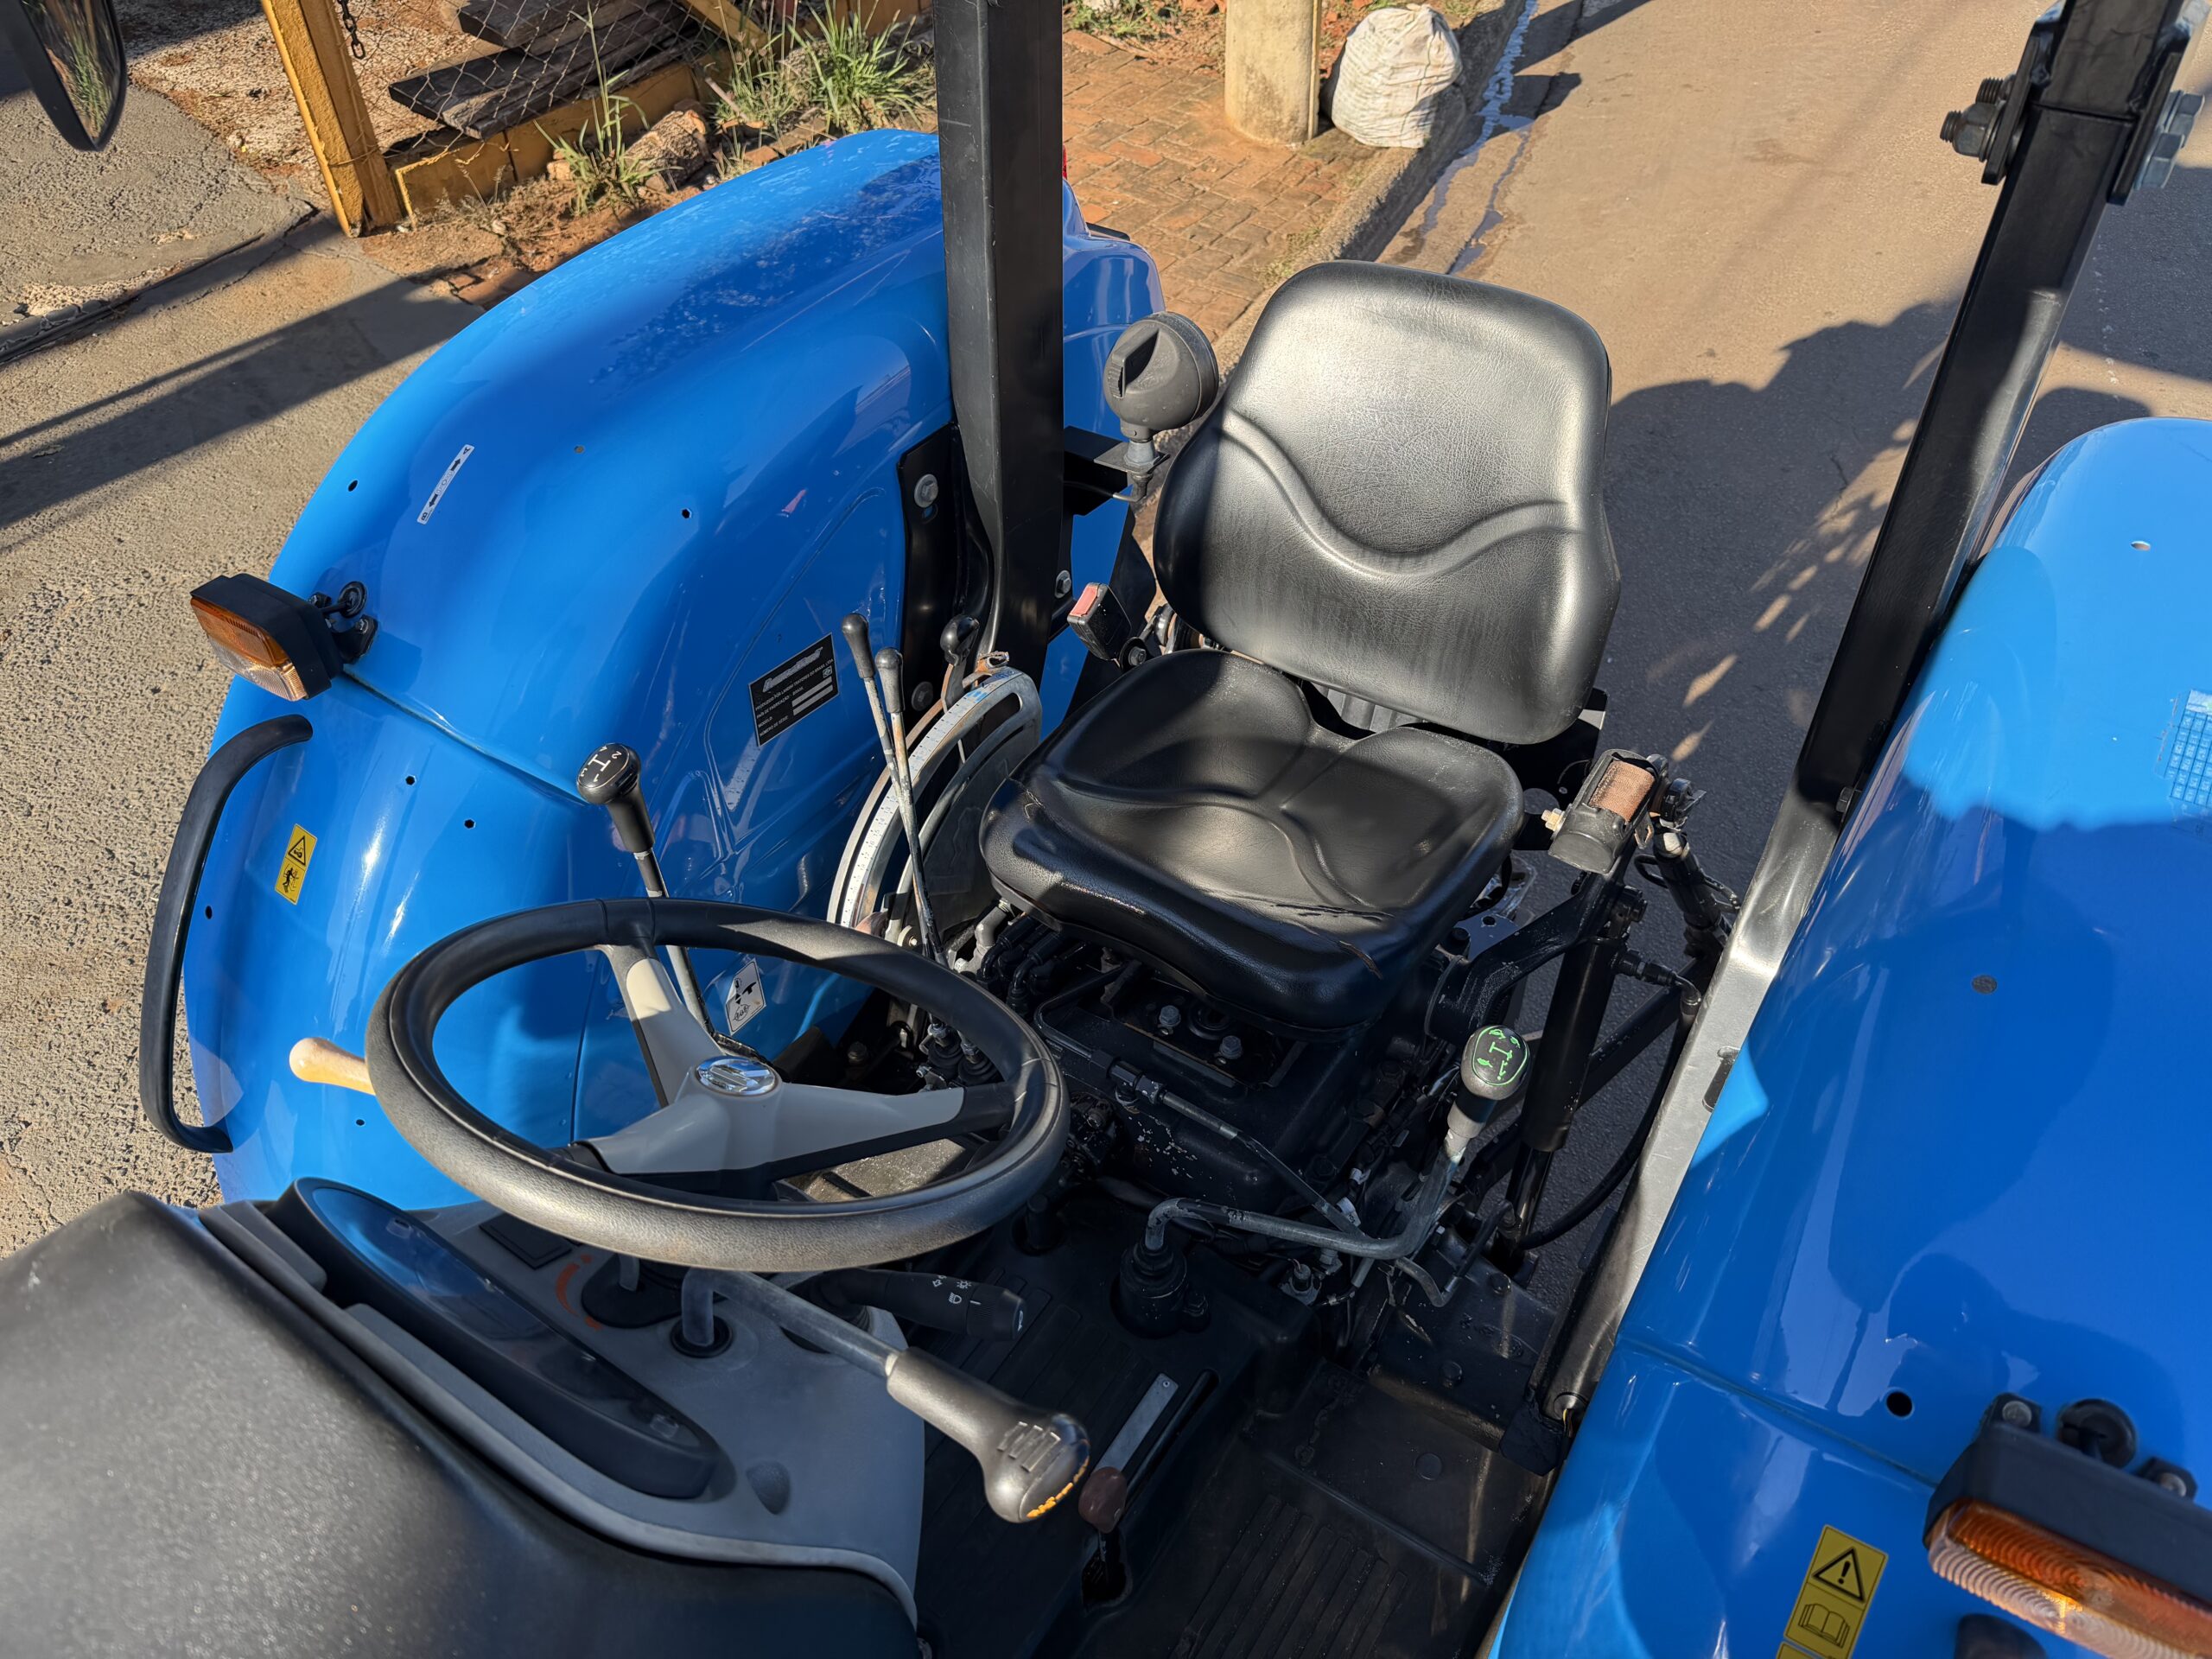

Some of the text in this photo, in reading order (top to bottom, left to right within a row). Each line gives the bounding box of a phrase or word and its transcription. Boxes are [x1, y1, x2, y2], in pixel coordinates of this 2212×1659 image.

[422, 512, 428, 521] B
[612, 751, 622, 760] 2
[580, 767, 600, 783] 3 1
